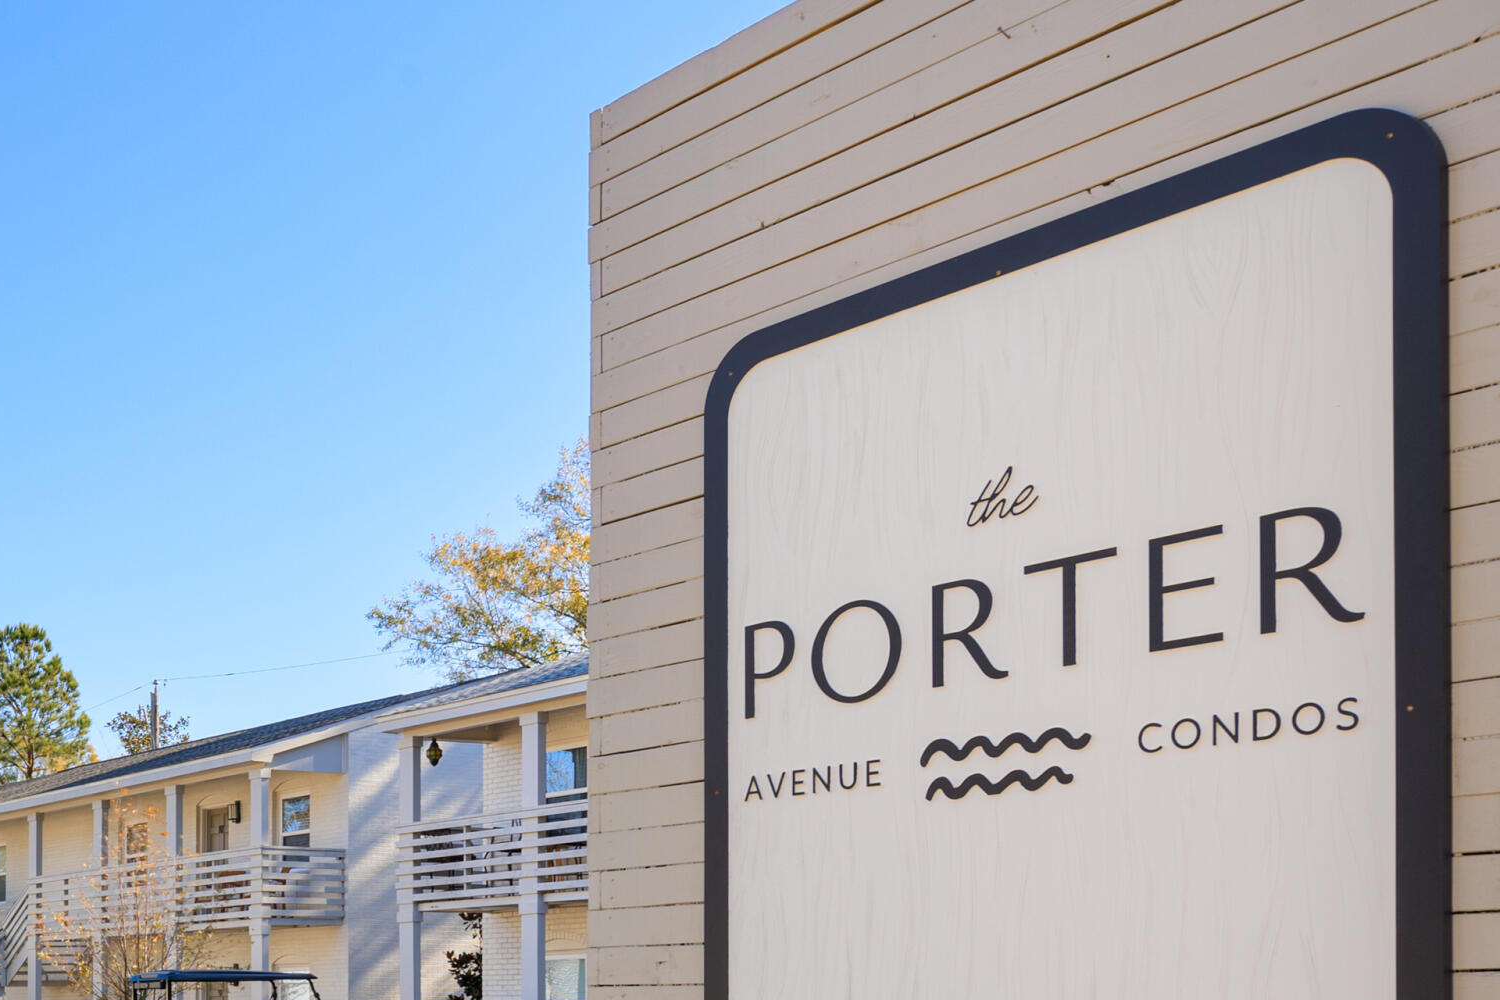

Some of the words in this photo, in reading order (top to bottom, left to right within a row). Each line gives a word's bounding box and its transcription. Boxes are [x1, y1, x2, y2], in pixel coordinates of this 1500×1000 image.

[966, 465, 1040, 528] the
[743, 505, 1366, 720] PORTER
[744, 759, 882, 802] AVENUE
[1137, 697, 1360, 754] CONDOS
